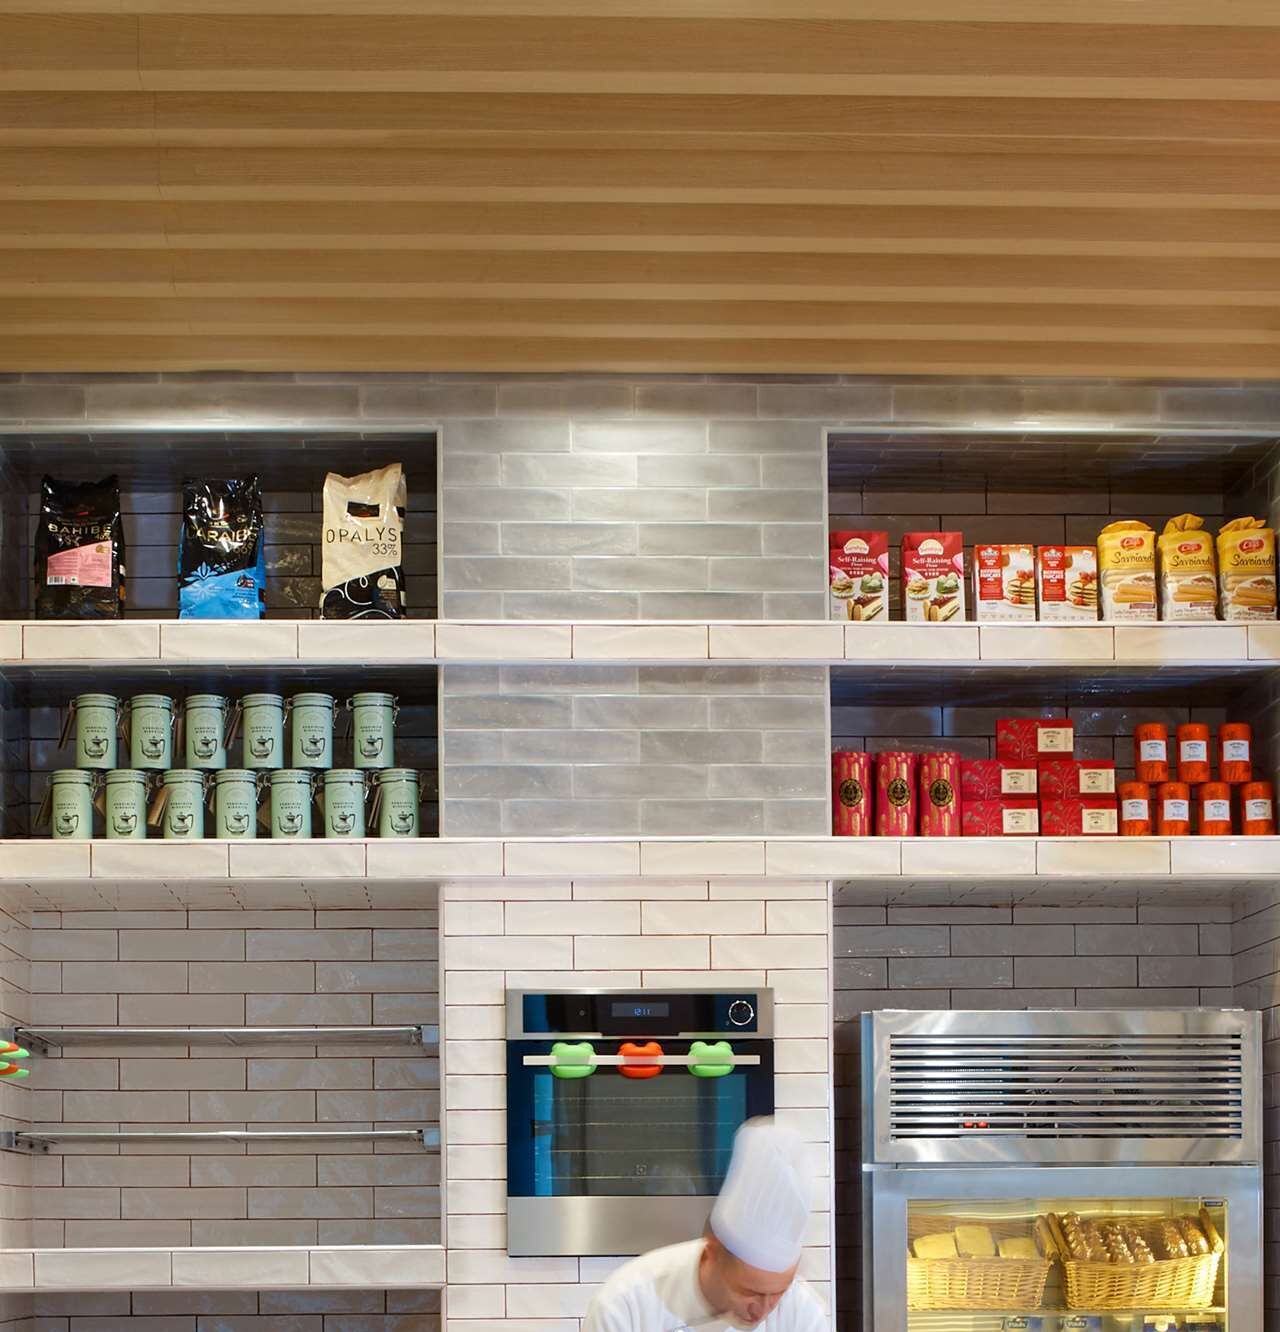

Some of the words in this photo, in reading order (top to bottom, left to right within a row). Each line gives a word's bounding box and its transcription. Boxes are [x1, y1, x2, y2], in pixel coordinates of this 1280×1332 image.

[326, 528, 397, 544] OPALYS
[372, 543, 398, 556] 33%
[1231, 554, 1274, 567] Savoiardi
